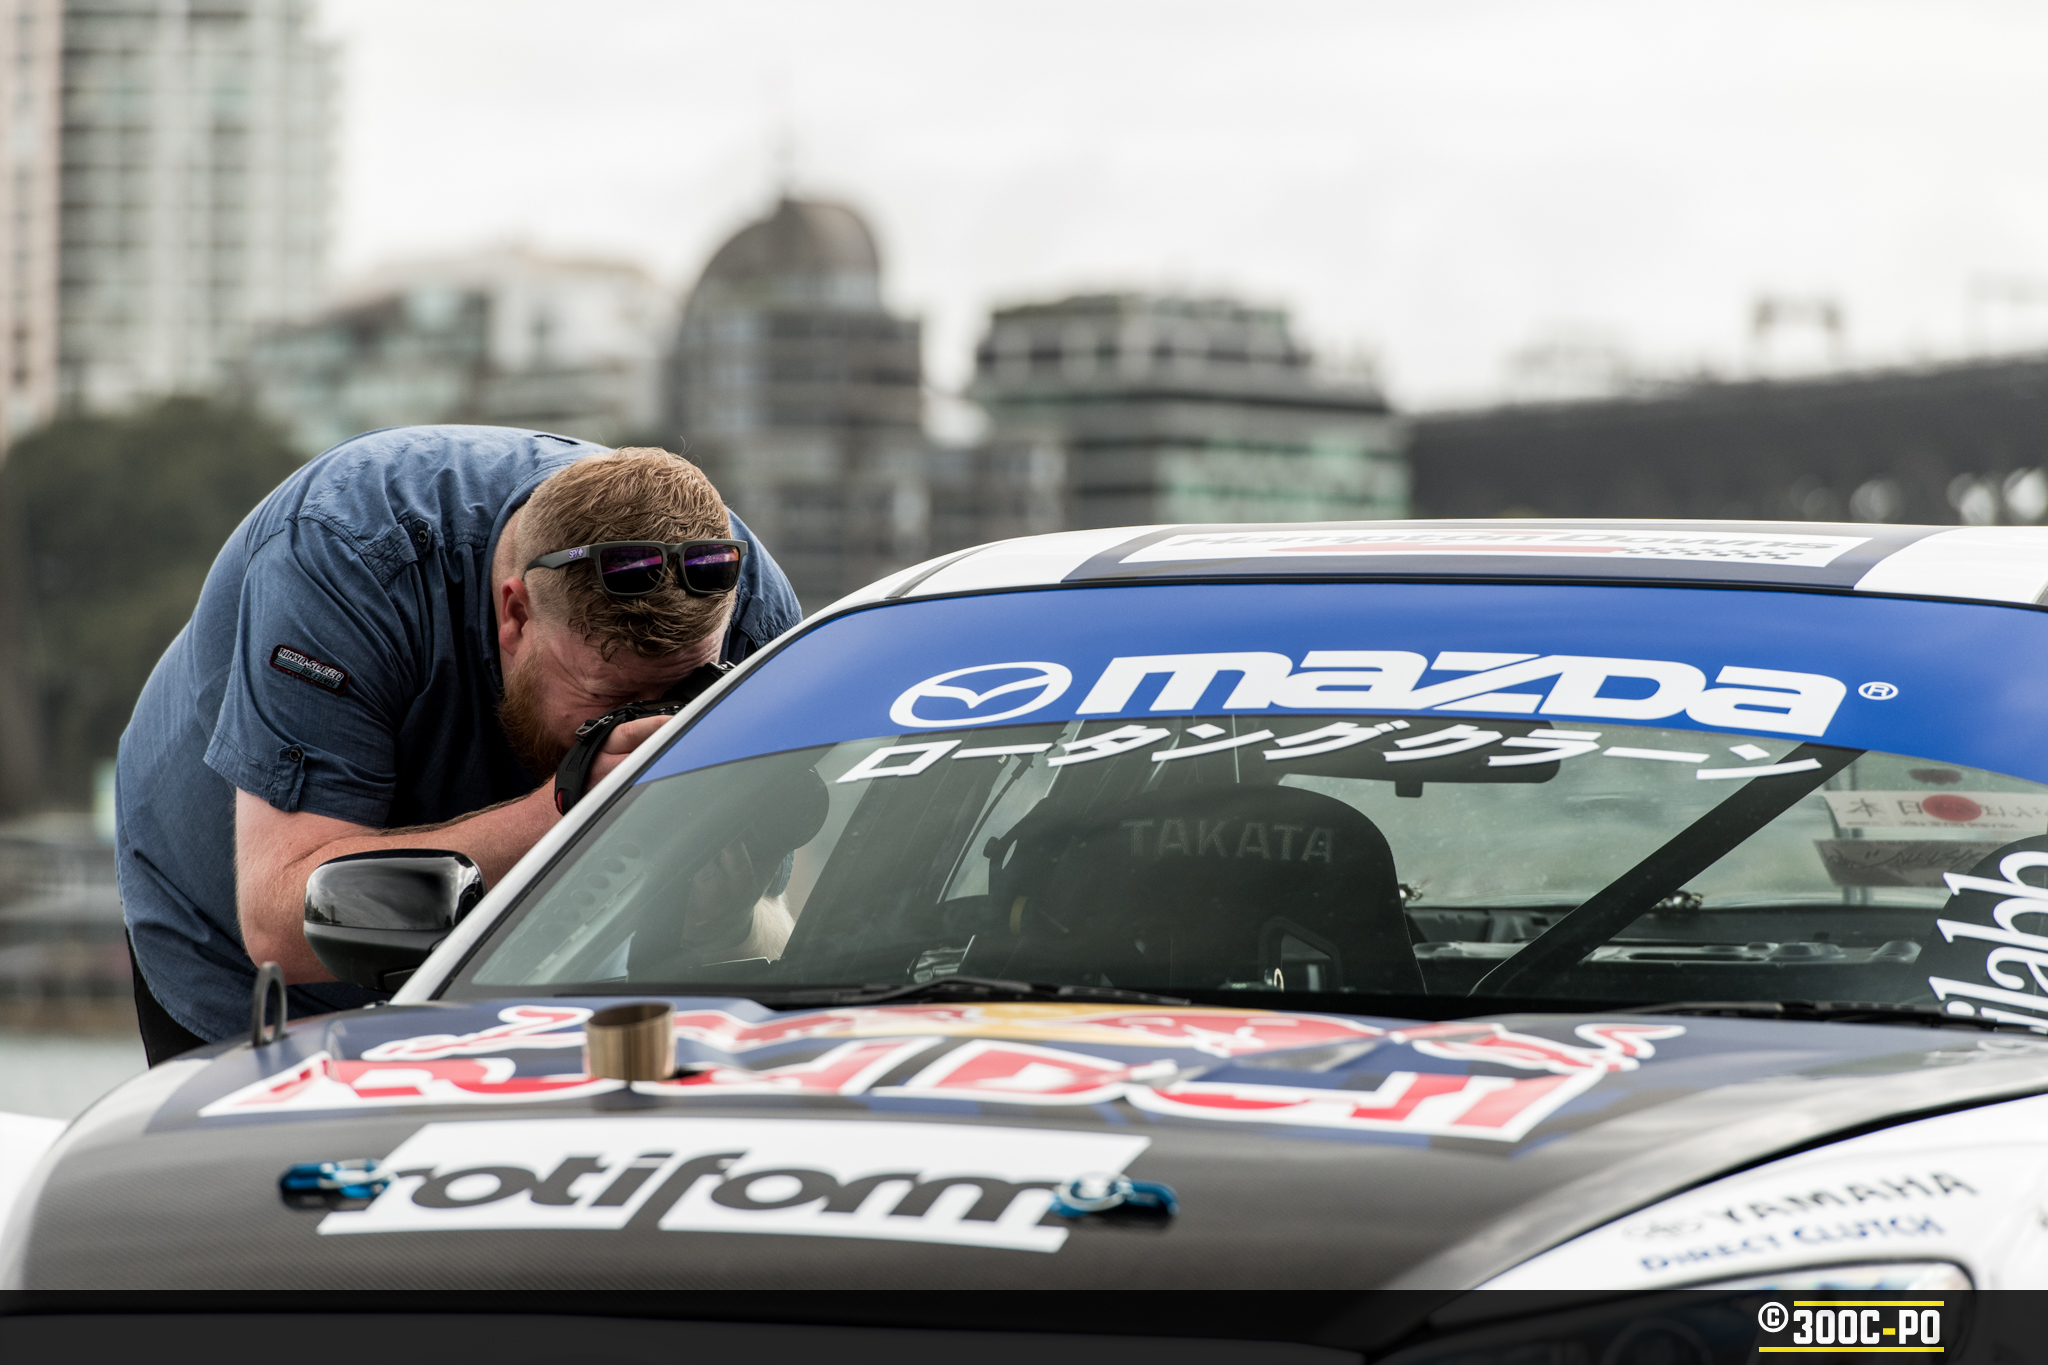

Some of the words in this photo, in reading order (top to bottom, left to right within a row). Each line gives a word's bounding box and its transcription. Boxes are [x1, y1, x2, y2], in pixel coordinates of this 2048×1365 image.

[1168, 534, 1543, 547] Hampton
[1548, 533, 1839, 549] Downs
[1120, 817, 1336, 864] TAKATA
[1704, 1172, 1978, 1224] YAMAHA
[1640, 1234, 1783, 1271] DIRECT
[1791, 1213, 1947, 1247] CLUTCH
